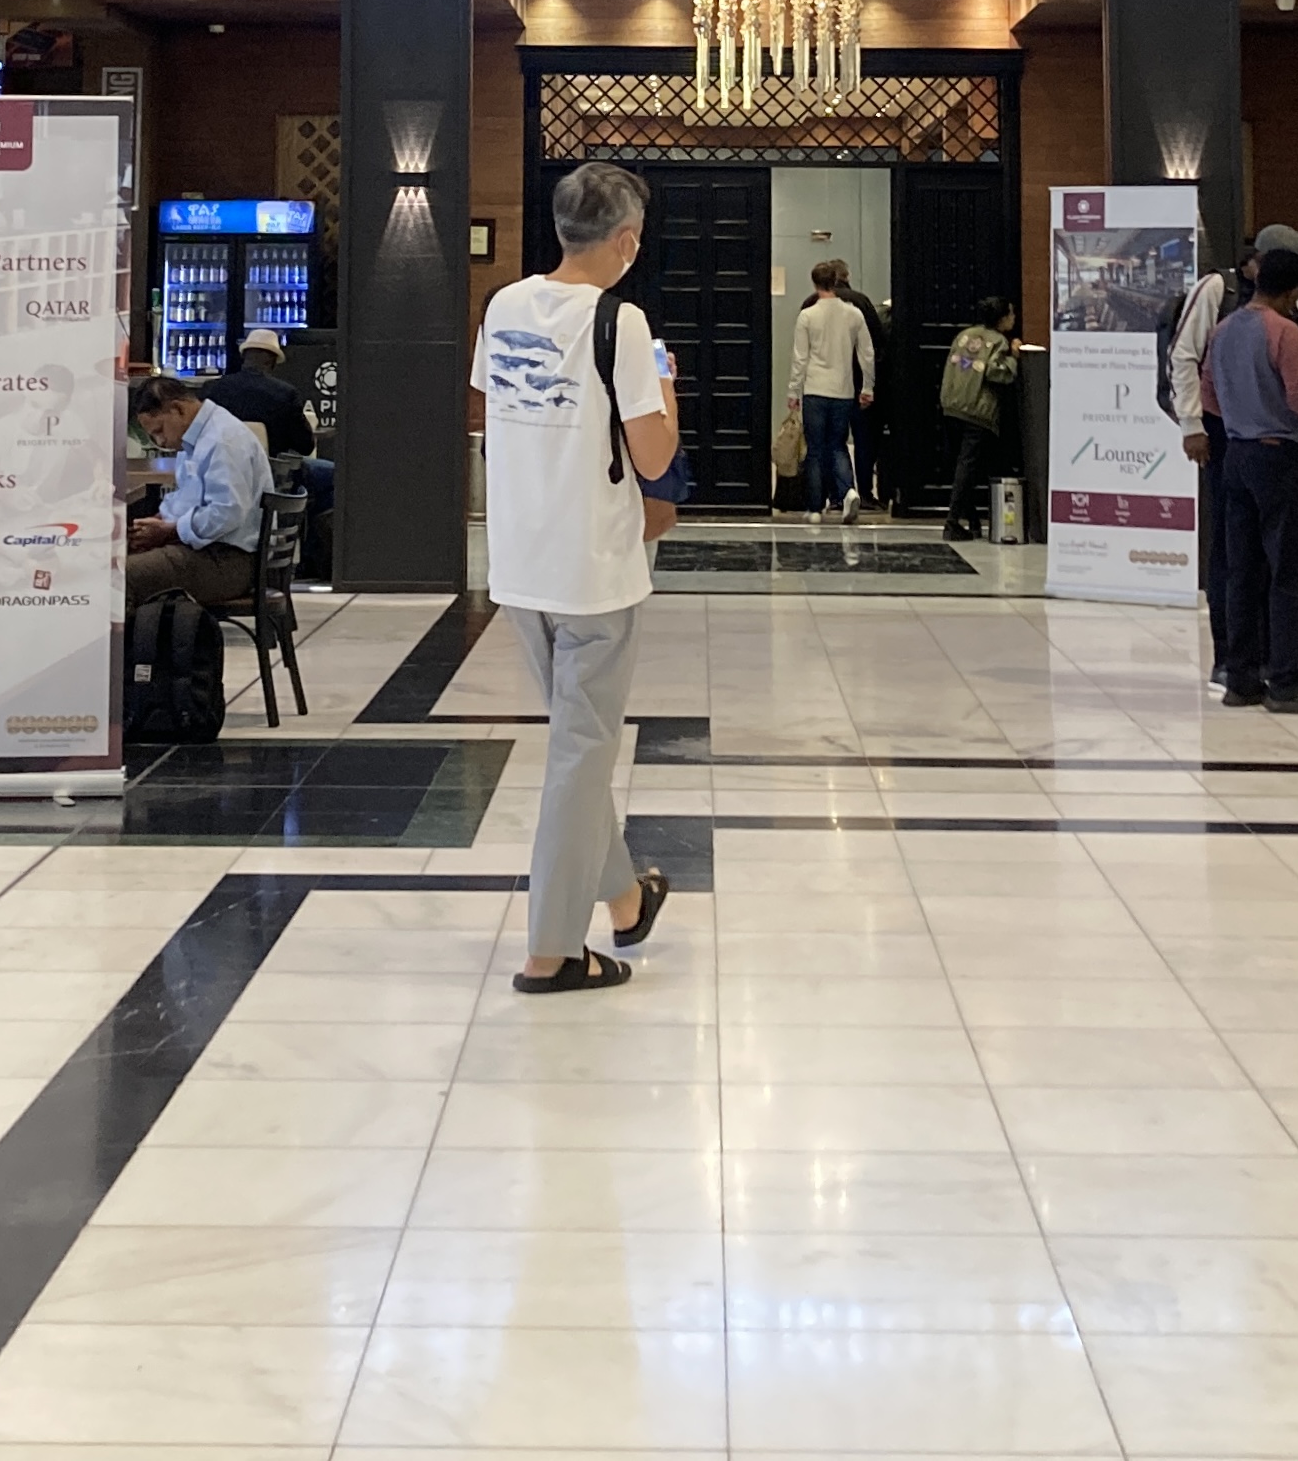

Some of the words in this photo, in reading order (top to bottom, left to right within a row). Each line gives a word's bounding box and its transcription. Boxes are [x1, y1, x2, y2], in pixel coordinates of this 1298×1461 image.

[26, 300, 89, 319] QATAR
[1100, 346, 1113, 354] and
[1082, 413, 1128, 423] PRIORITY
[1094, 442, 1155, 467] Lounge
[1119, 463, 1141, 475] KEY
